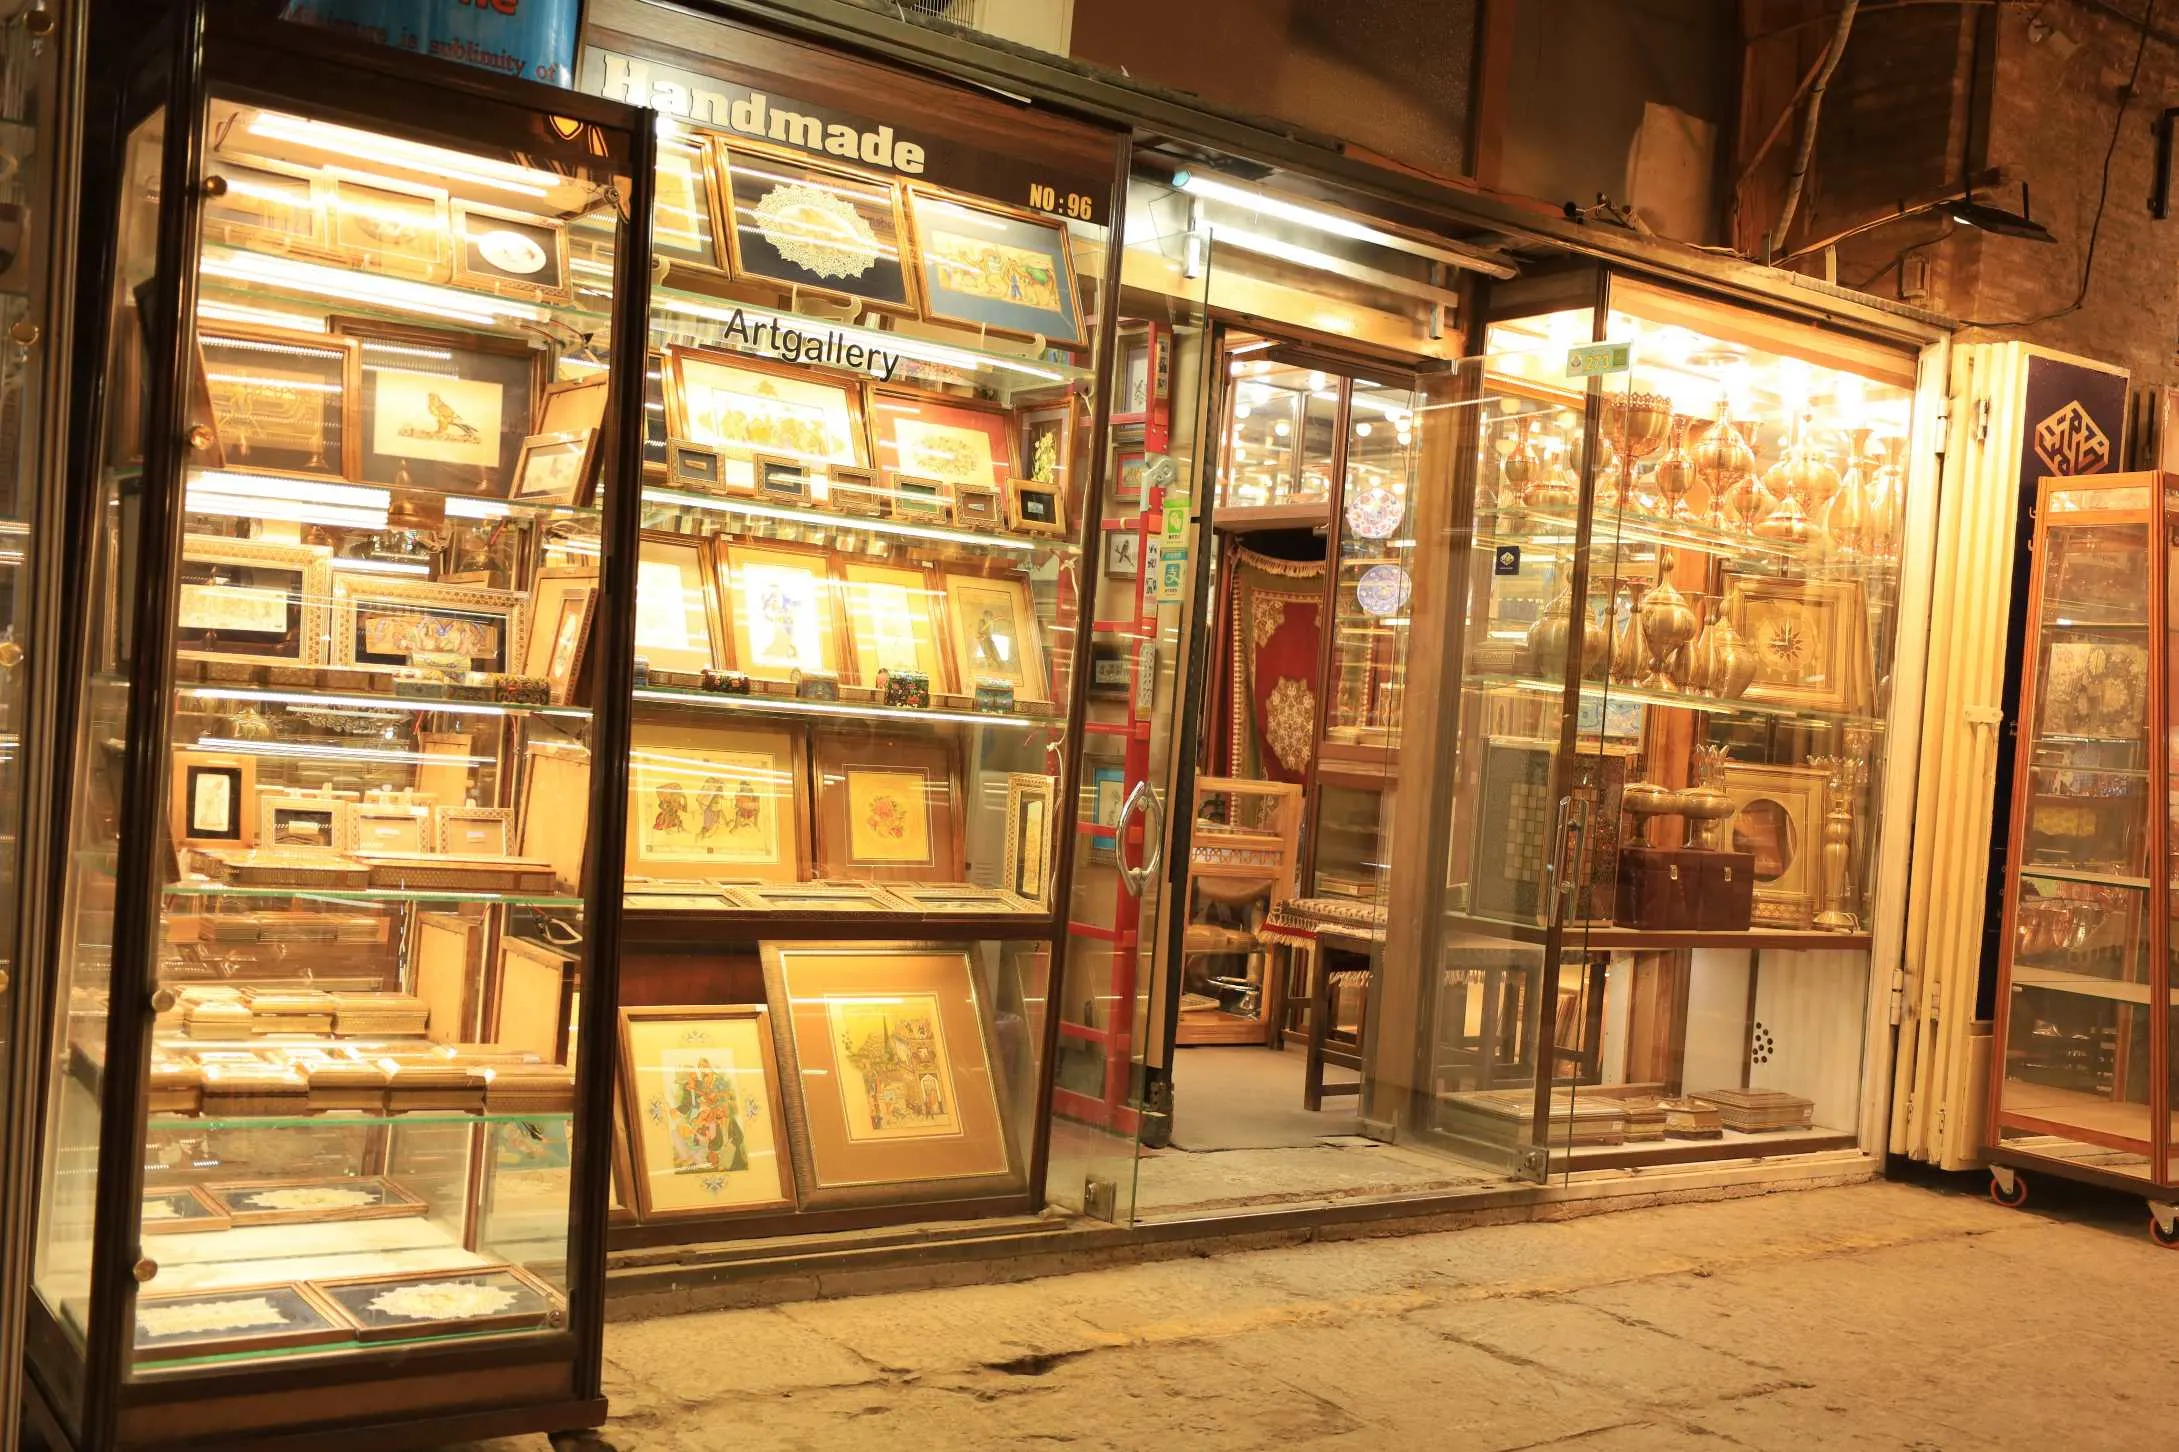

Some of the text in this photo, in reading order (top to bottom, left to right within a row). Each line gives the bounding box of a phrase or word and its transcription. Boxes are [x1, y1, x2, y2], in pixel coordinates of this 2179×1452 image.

[430, 37, 526, 78] sublimity
[535, 63, 559, 81] of
[601, 54, 926, 174] Handmade
[724, 308, 900, 383] Artgallery
